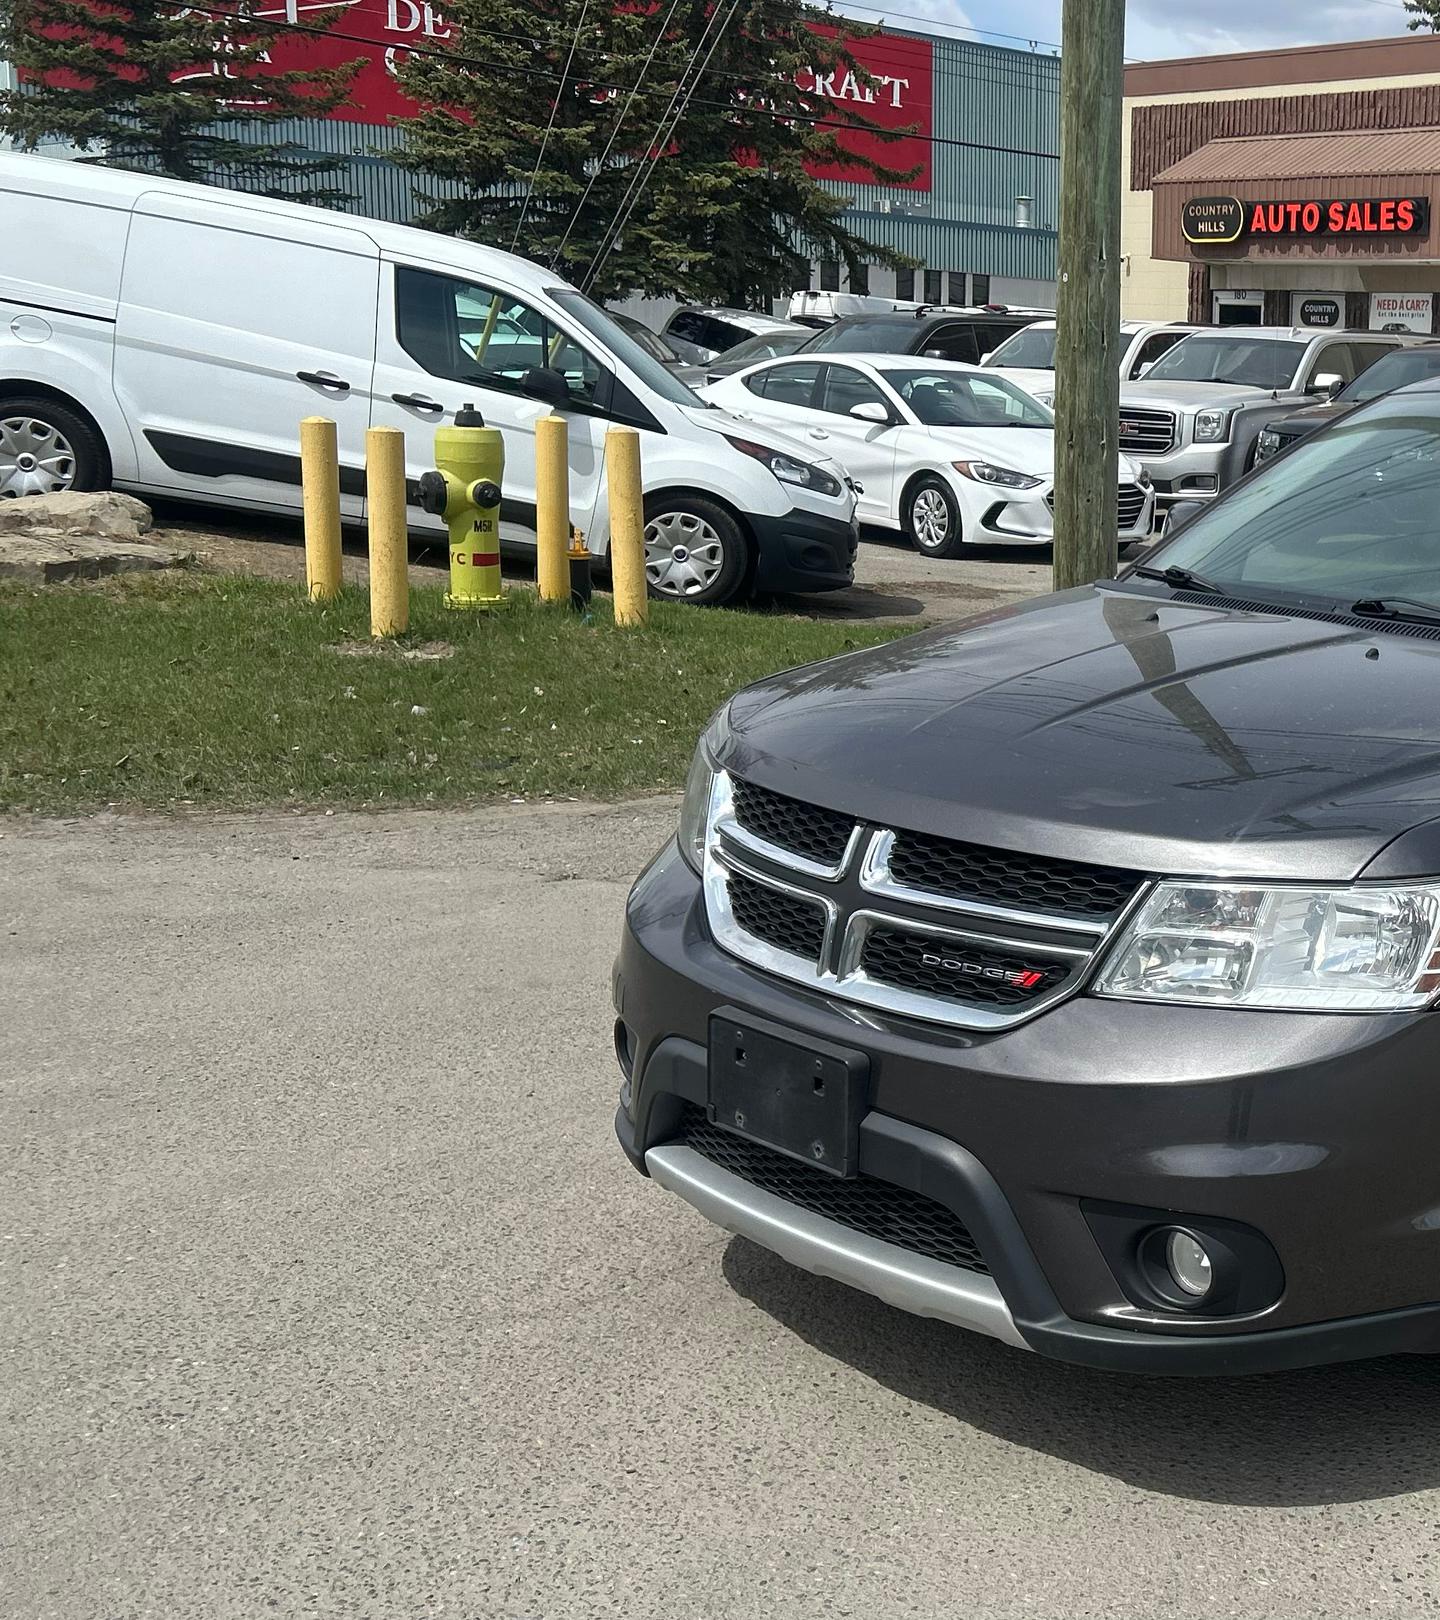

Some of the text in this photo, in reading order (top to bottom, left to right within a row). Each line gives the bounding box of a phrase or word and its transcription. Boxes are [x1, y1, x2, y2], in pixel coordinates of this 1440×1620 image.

[1189, 204, 1235, 216] COUNTRY
[1251, 200, 1415, 233] AUTO SALES
[1198, 220, 1226, 233] HILLS
[1304, 304, 1336, 313] COUNTRY
[1376, 299, 1430, 311] NEED A CAR??
[1310, 315, 1329, 324] HILLS
[922, 953, 1025, 983] DODGE
